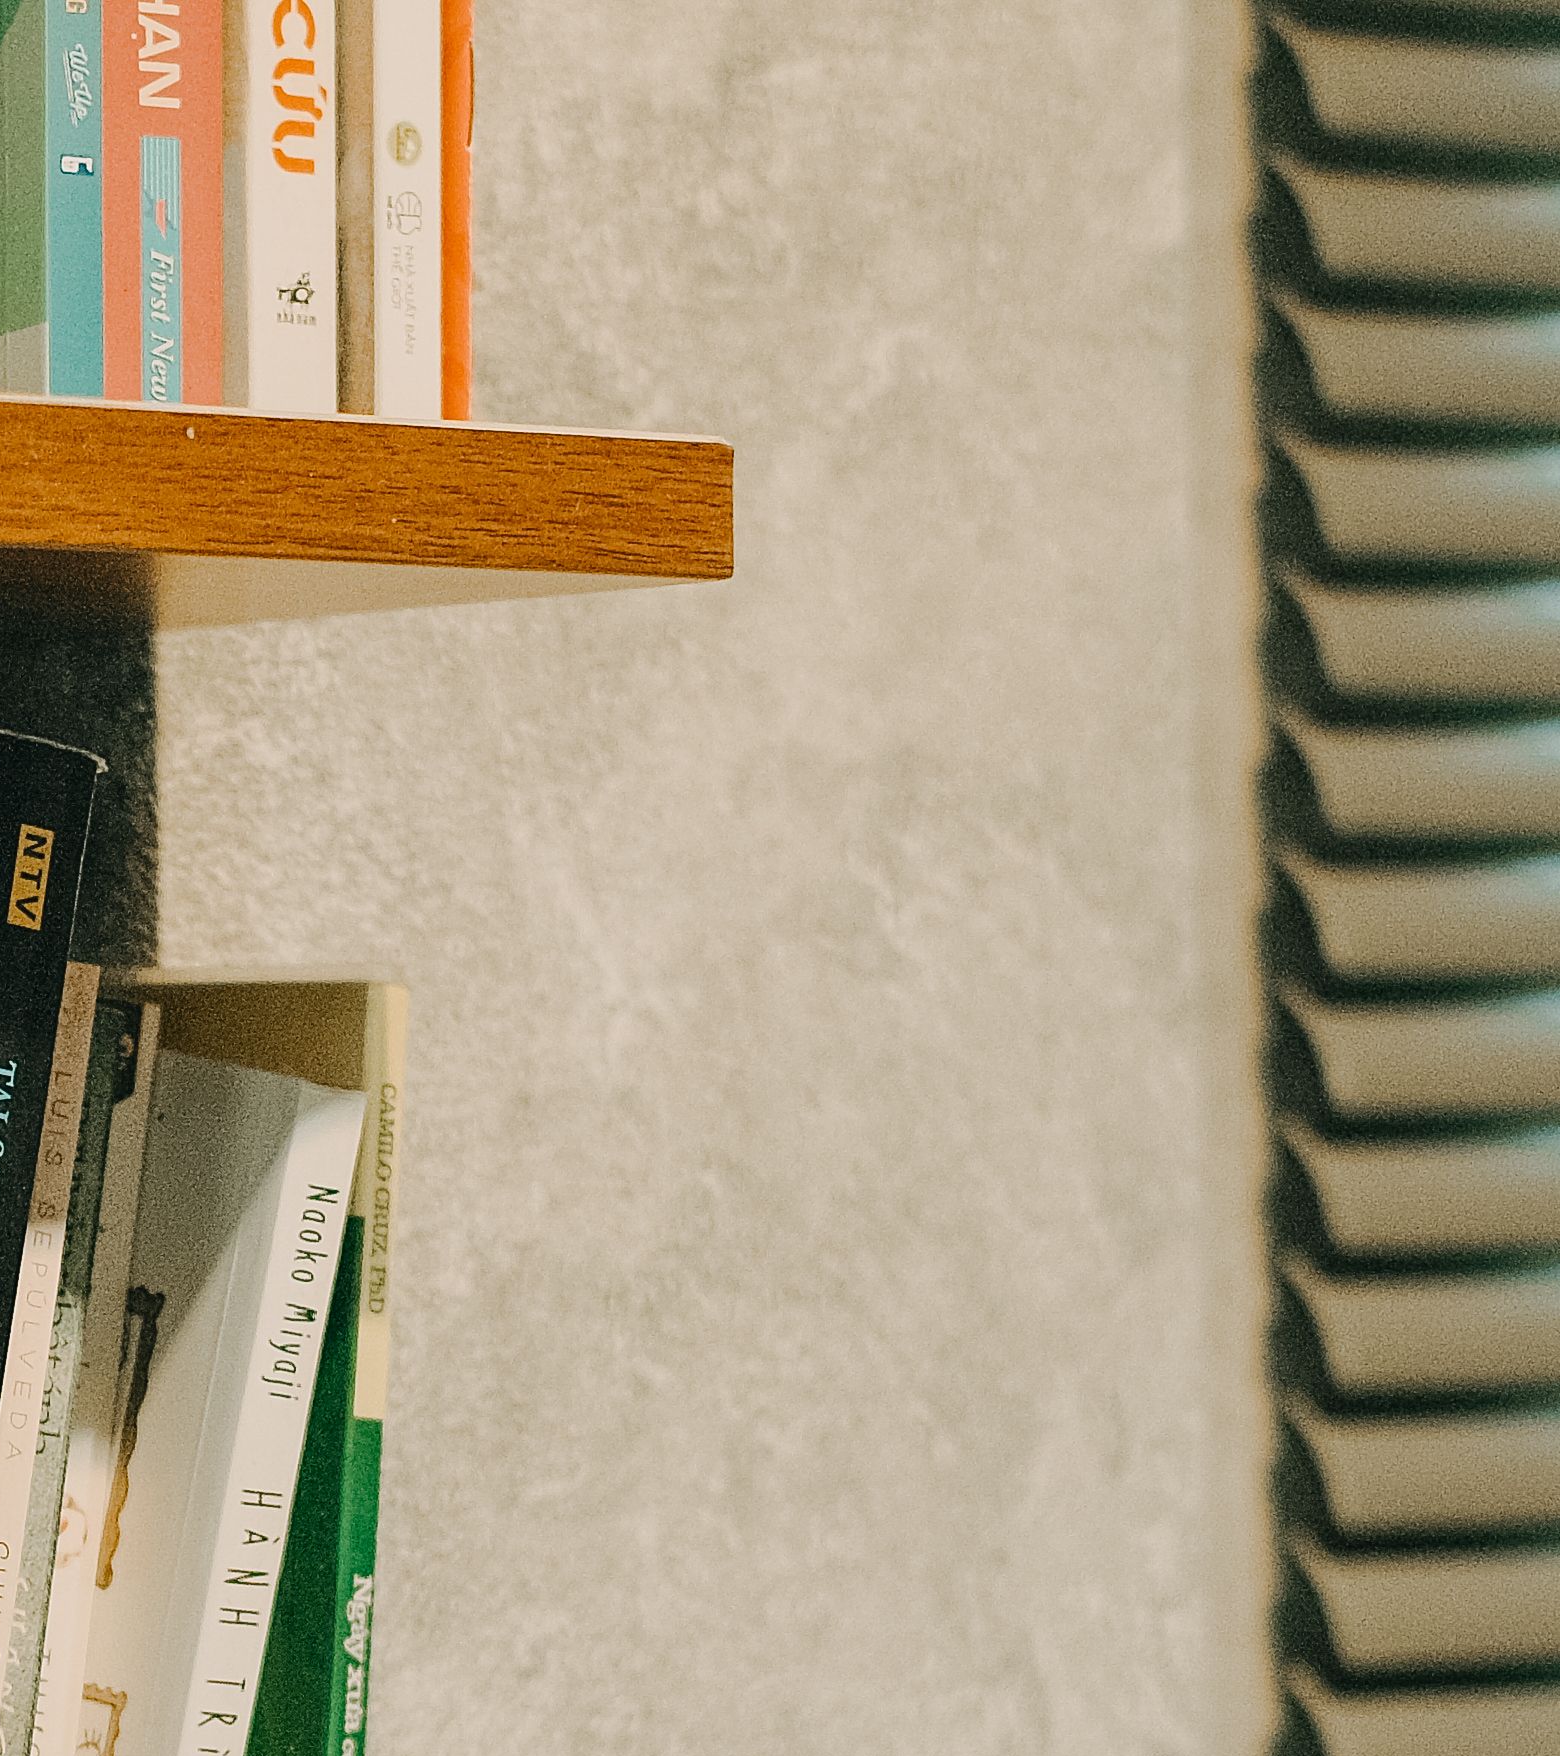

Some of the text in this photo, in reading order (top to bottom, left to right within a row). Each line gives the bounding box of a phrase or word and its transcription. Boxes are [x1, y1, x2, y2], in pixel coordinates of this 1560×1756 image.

[271, 0, 327, 176] CỨU
[149, 249, 175, 324] First
[14, 830, 47, 920] NTV
[2, 1070, 73, 1463] LUIS SEPÚLVEDA
[262, 1184, 339, 1400] Naoko Miyaji
[220, 1489, 282, 1627] HÀNH
